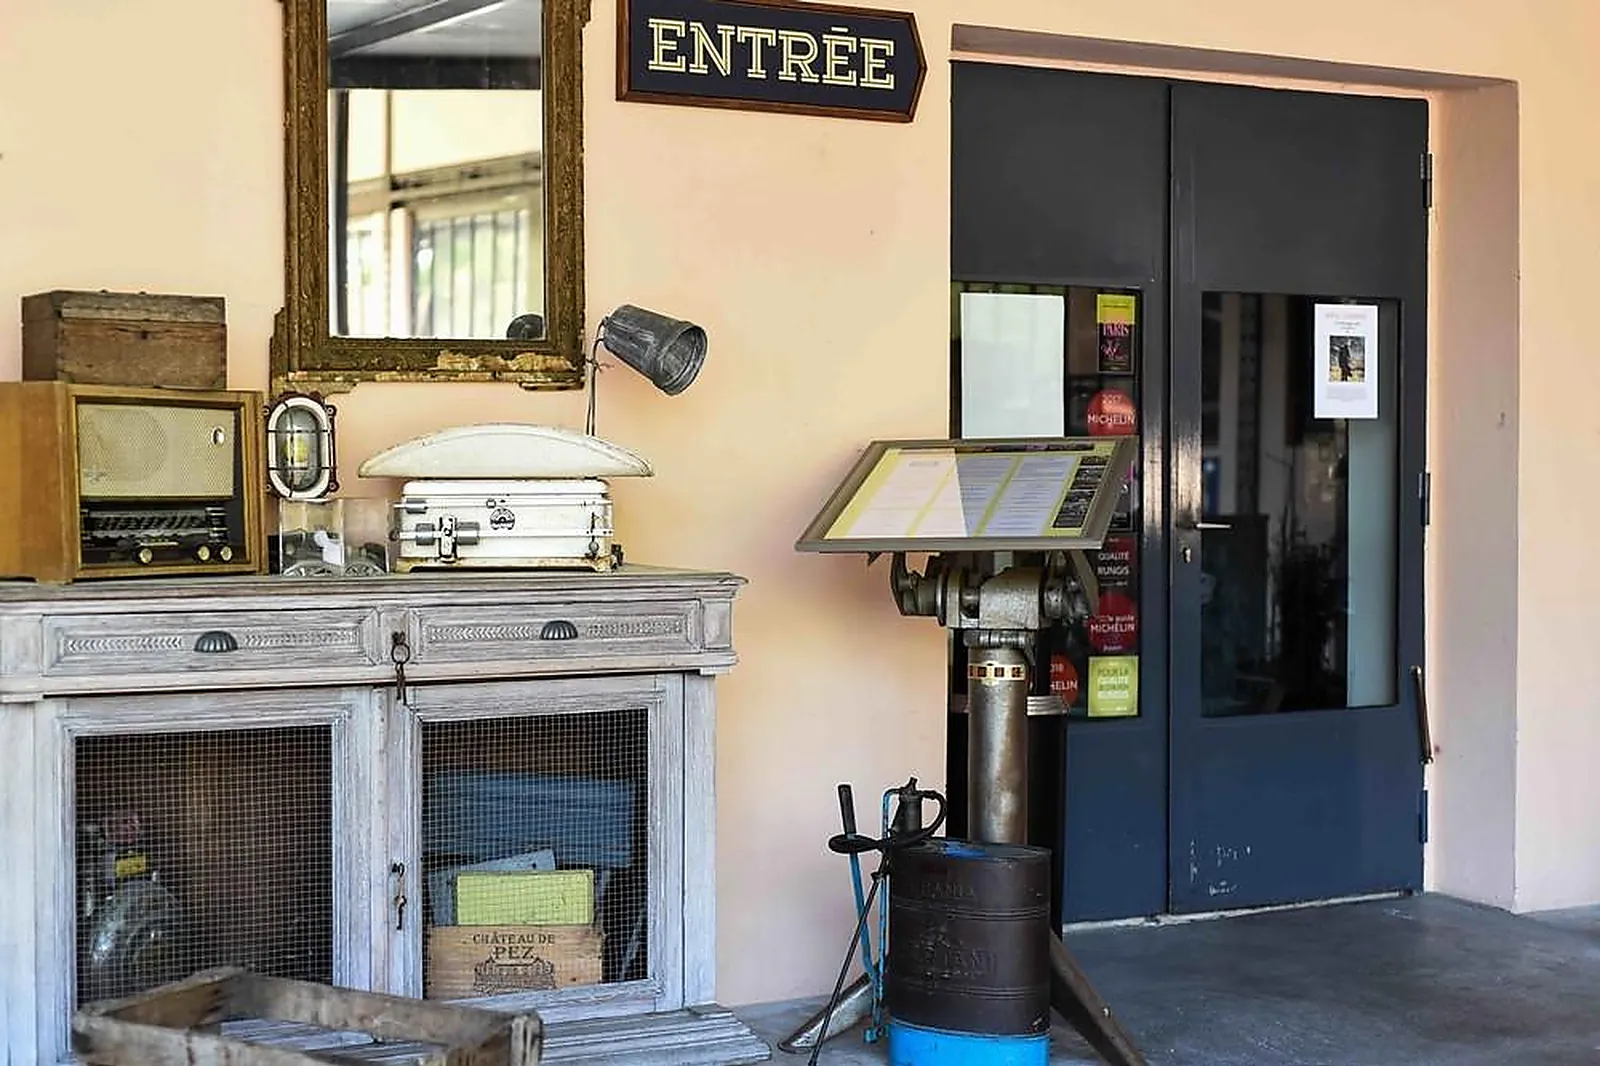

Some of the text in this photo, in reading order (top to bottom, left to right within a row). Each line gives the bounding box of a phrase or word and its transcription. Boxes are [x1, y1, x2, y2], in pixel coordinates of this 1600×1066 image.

[648, 18, 895, 90] ENTRÉE
[1087, 411, 1136, 425] MICHELIN
[1090, 622, 1136, 634] MICHELIN
[473, 932, 556, 945] CHÂTEAU DE
[493, 945, 536, 960] PEZ
